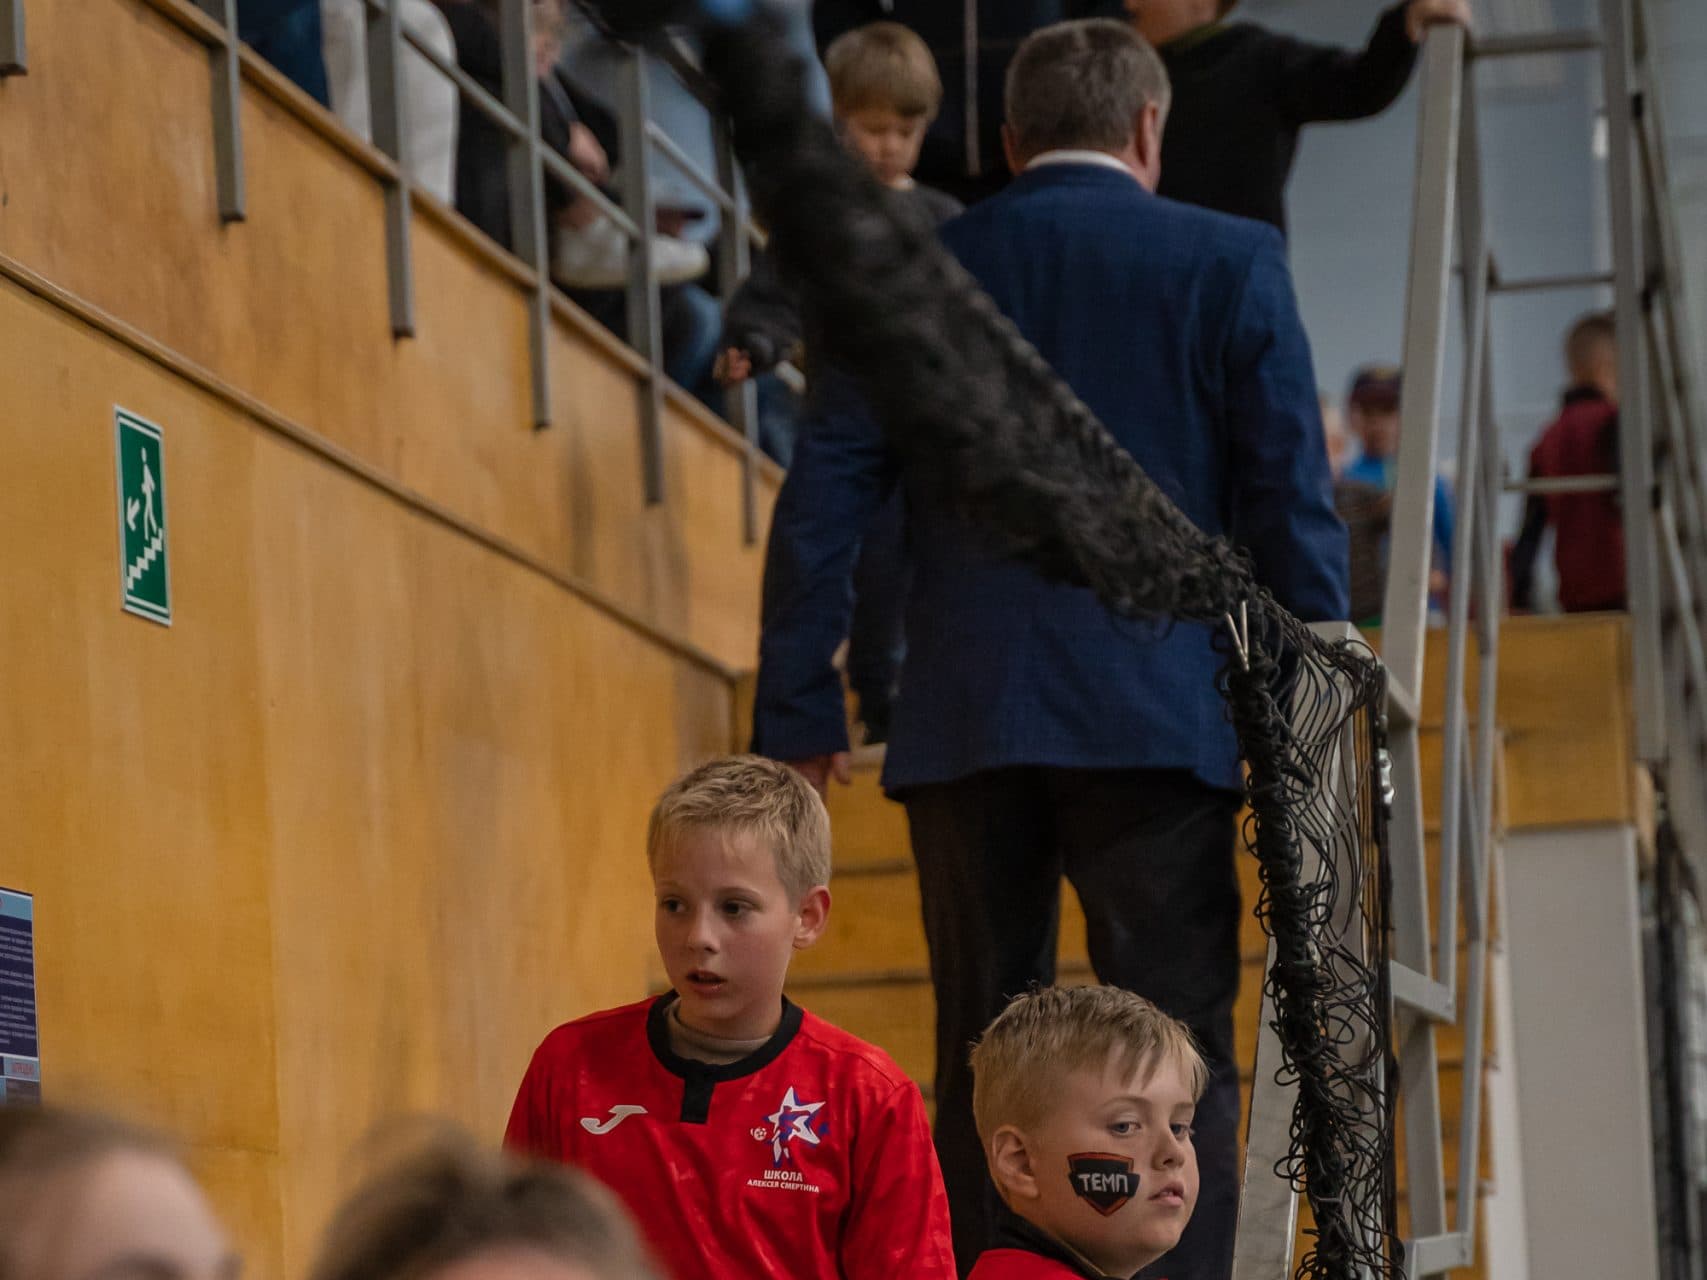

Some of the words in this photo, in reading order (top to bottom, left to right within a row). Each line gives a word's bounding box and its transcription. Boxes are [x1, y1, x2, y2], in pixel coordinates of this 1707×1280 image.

[764, 1169, 803, 1182] ШКОЛА
[1077, 1172, 1129, 1193] ТЕМП
[746, 1179, 779, 1188] АЛЕКСЕЯ
[780, 1181, 820, 1193] СМЕРТИНА
